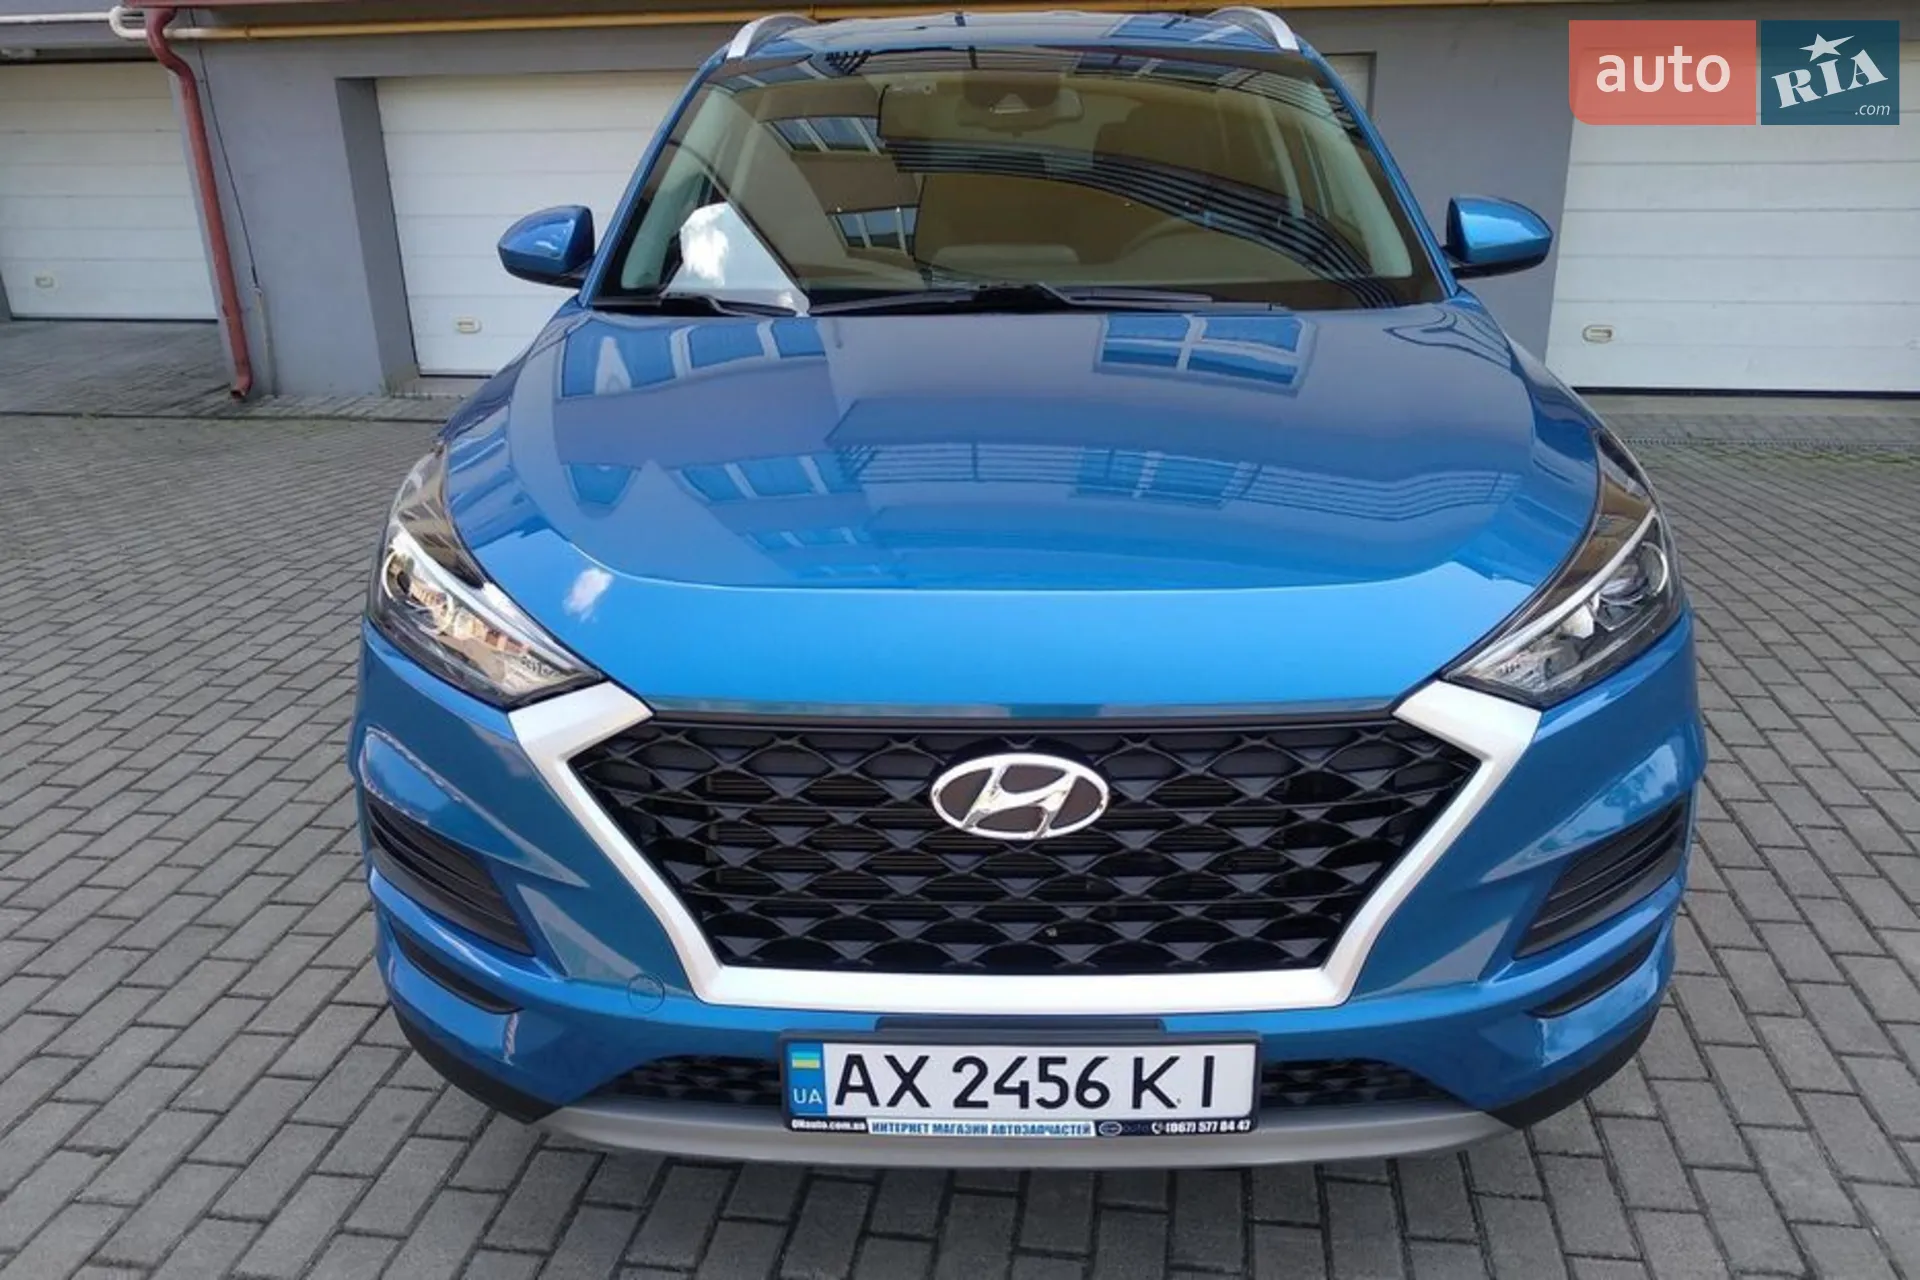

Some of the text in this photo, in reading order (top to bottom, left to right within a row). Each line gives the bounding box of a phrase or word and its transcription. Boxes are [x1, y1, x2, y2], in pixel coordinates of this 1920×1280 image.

[834, 1053, 931, 1108] AX
[952, 1055, 1111, 1110] 2456
[793, 1088, 823, 1104] UA
[872, 1121, 930, 1134] ИНТЕРНЕТ
[932, 1123, 988, 1135] МАГАЗИН
